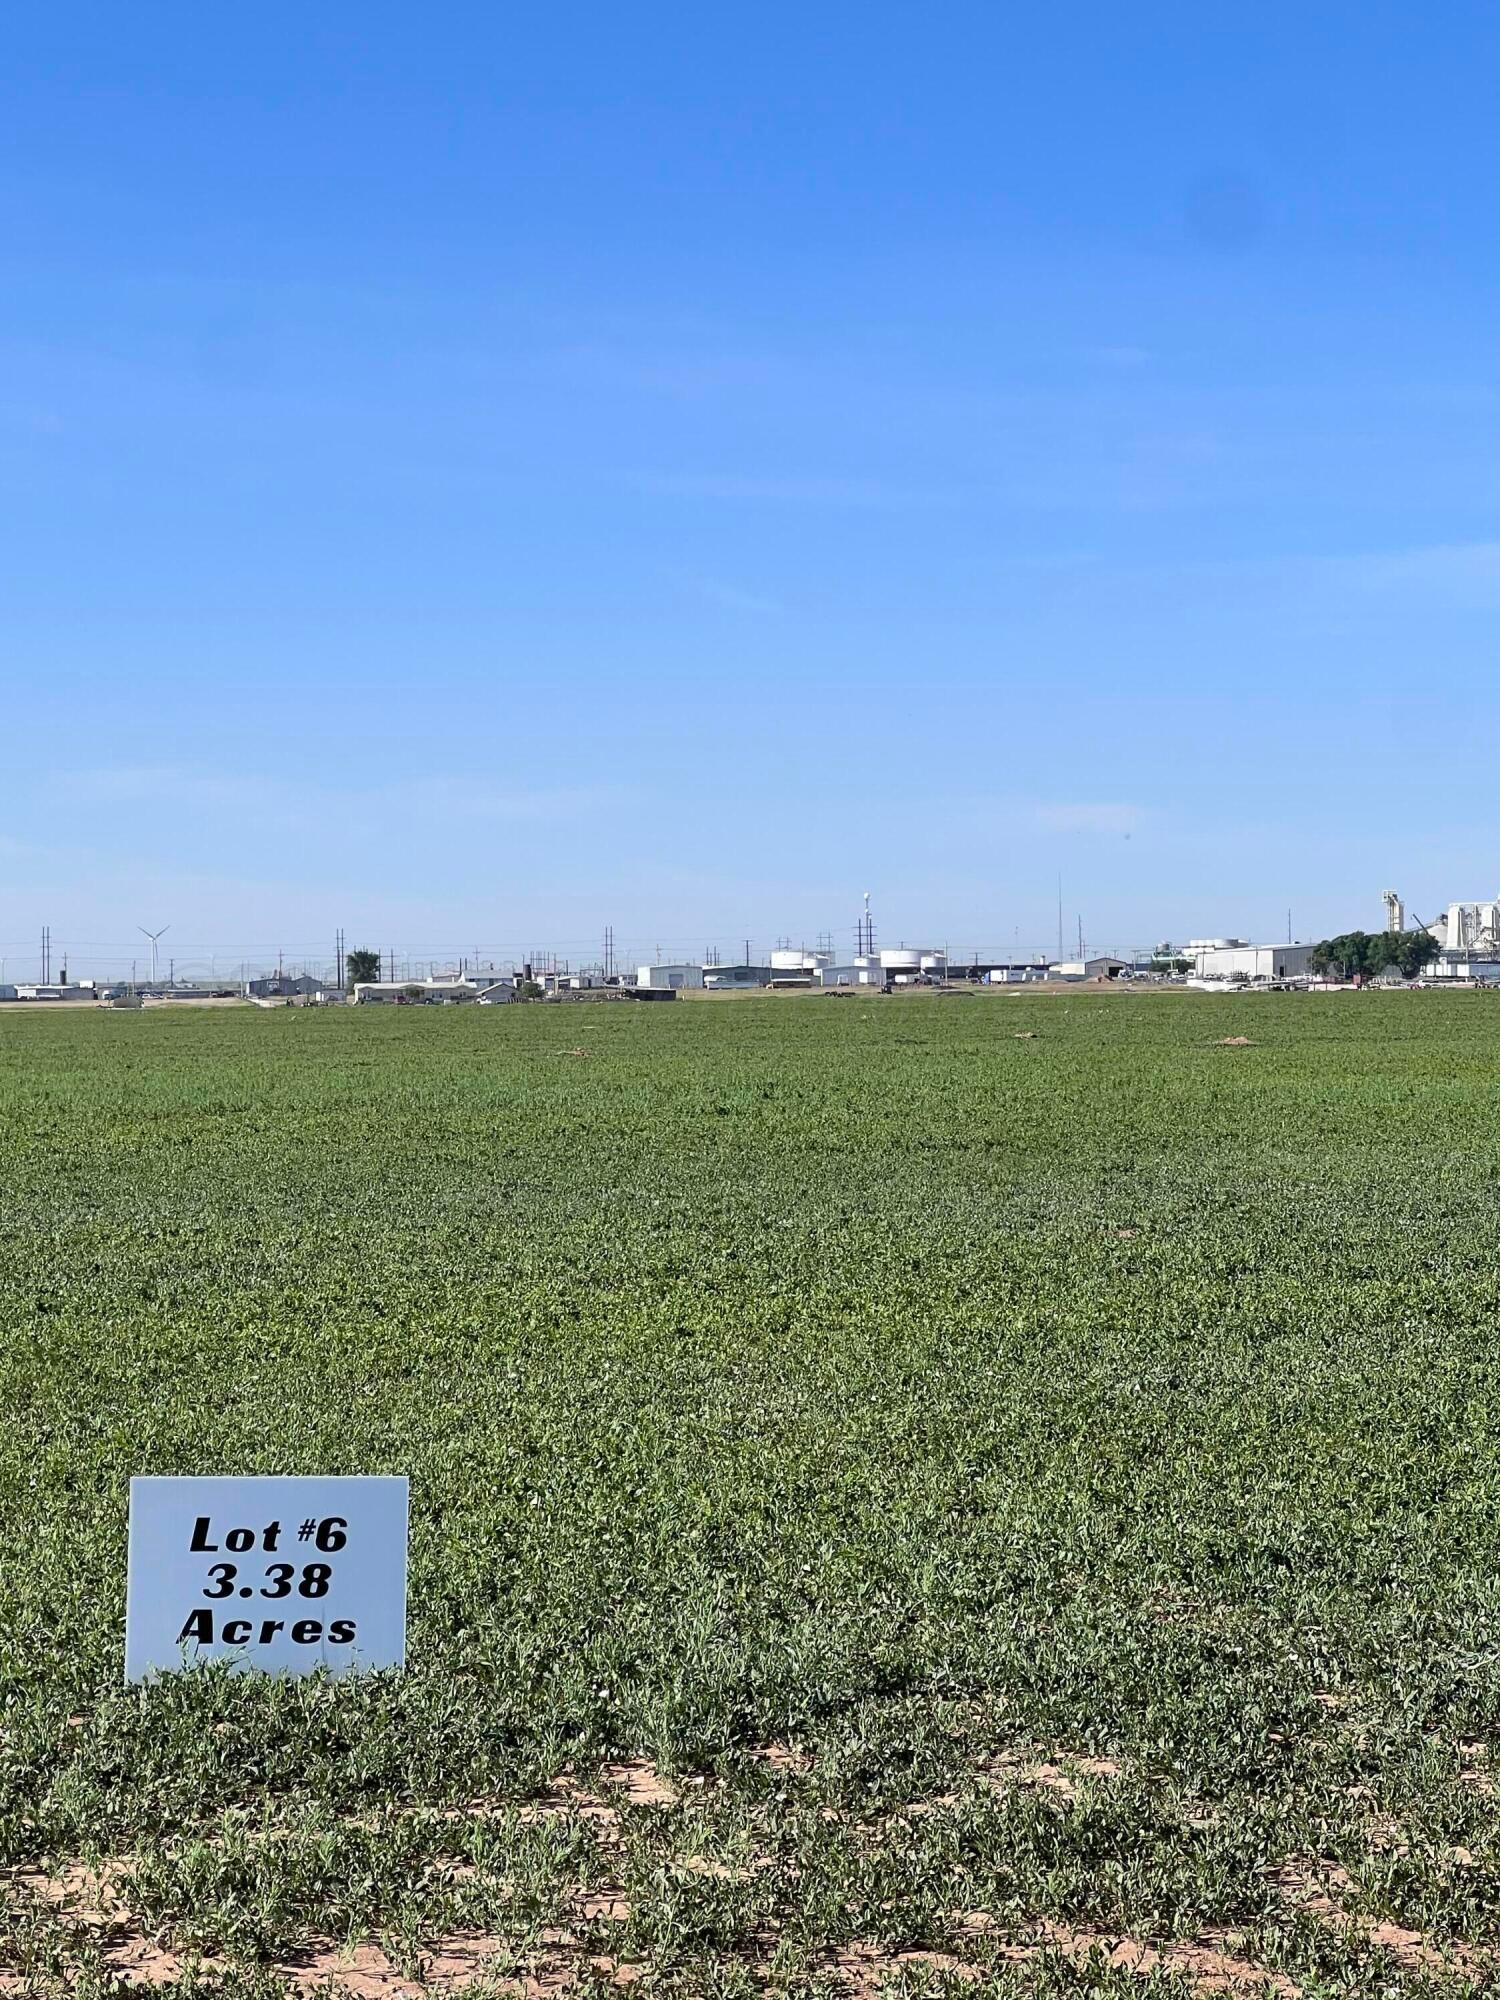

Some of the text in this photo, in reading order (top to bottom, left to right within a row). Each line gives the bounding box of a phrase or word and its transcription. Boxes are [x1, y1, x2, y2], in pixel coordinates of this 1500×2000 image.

[189, 1517, 348, 1553] Lot #6
[202, 1563, 333, 1599] 3.38
[175, 1609, 358, 1645] Acres
